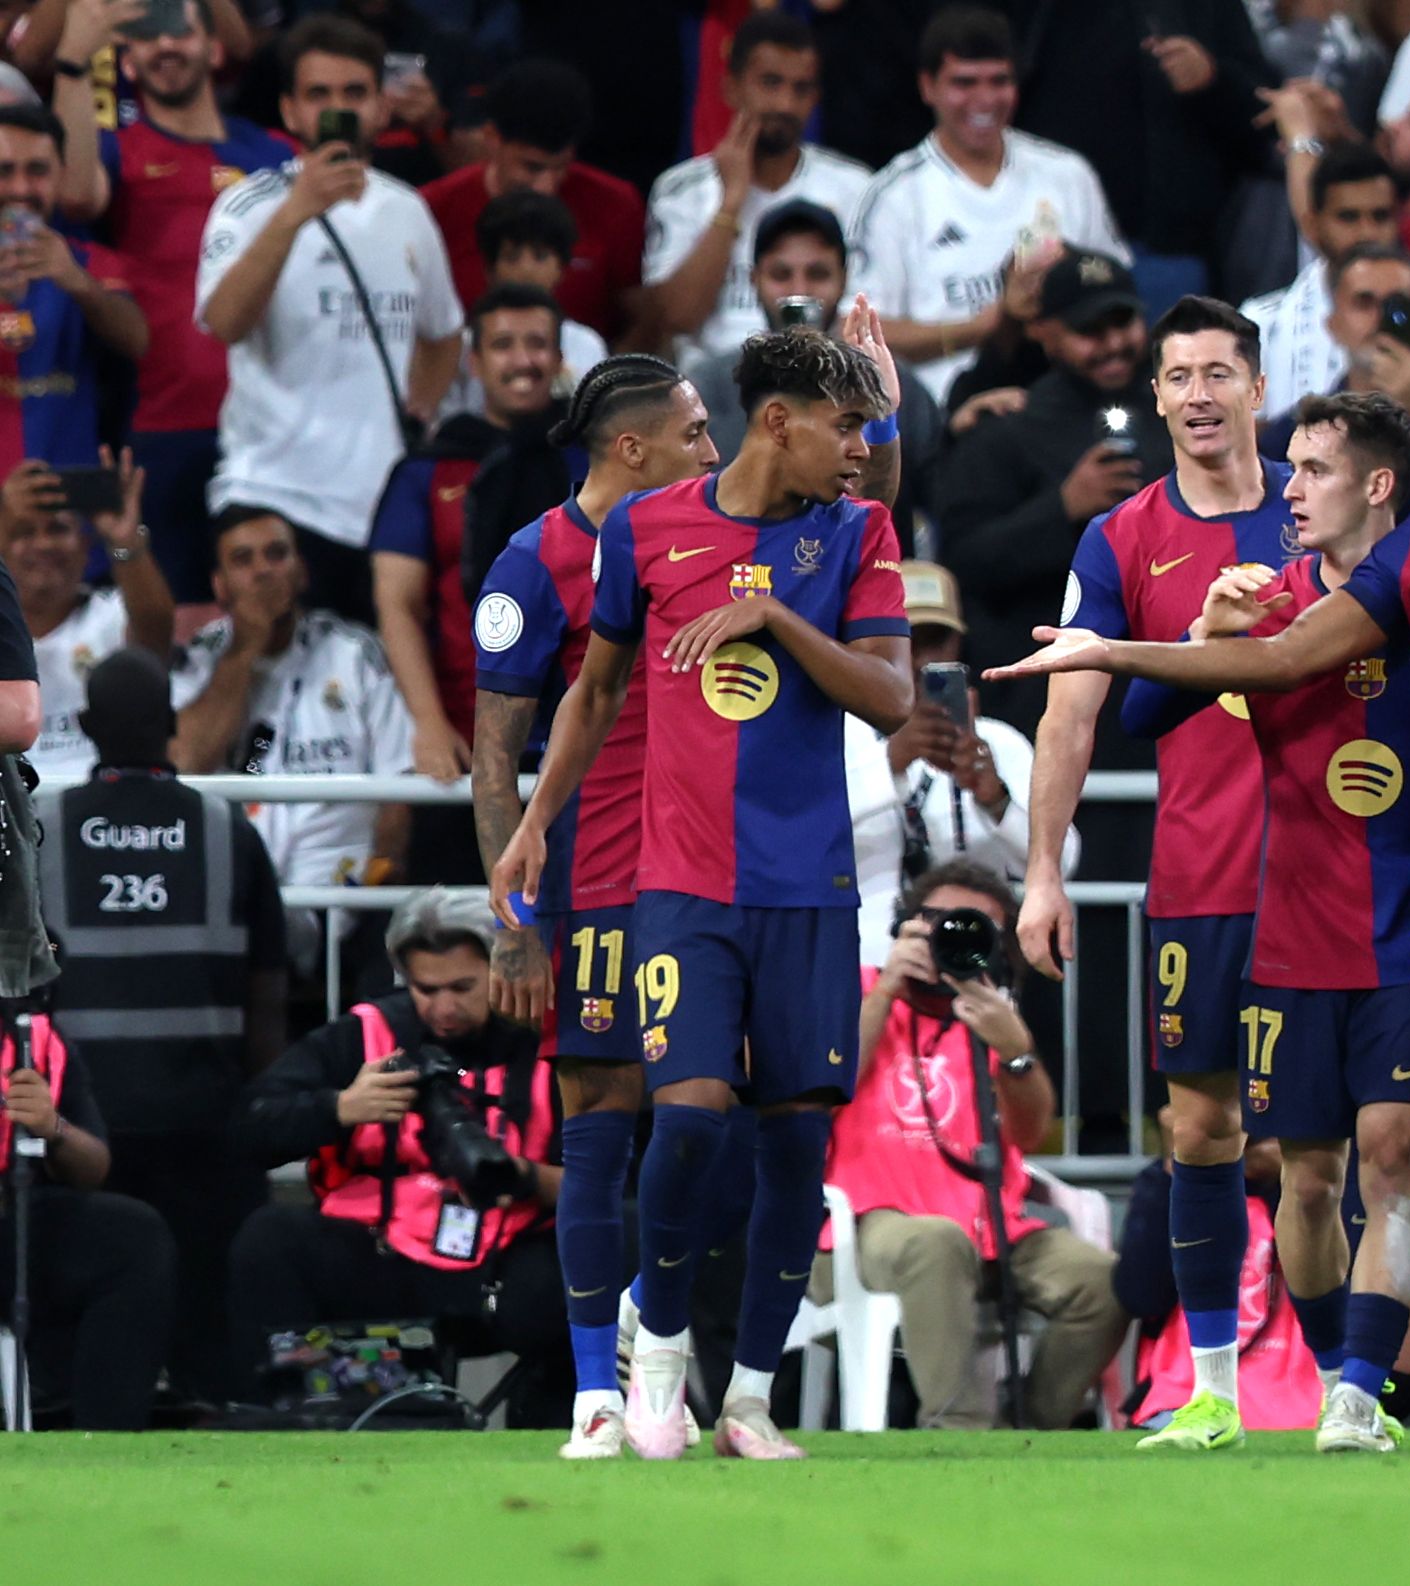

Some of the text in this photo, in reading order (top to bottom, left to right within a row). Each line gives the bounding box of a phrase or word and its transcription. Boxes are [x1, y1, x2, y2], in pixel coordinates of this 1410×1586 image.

[80, 816, 186, 850] Guard
[98, 873, 169, 912] 236
[571, 926, 624, 995] 11
[634, 953, 680, 1027] 19
[1158, 941, 1187, 1007] 9
[1239, 1005, 1283, 1075] 17
